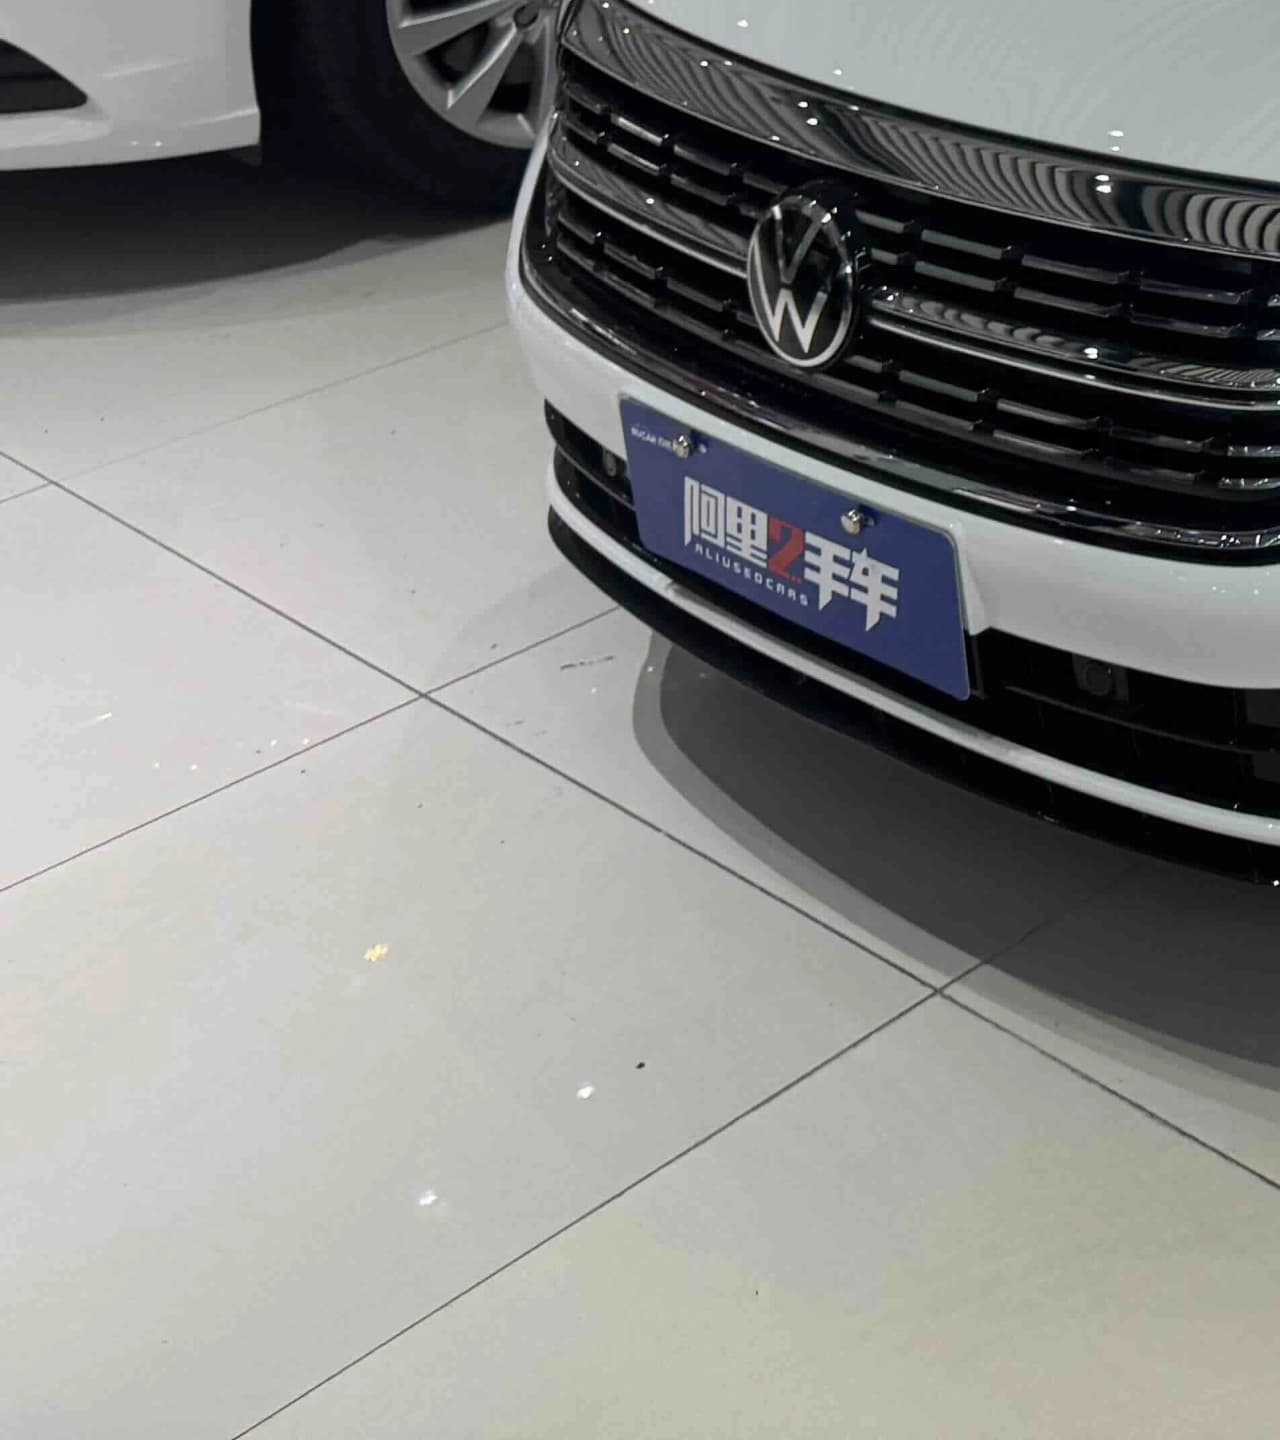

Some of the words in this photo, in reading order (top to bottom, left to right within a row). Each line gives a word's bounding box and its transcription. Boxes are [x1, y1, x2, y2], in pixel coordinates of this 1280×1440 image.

[683, 475, 900, 633] 阿里2手车
[694, 542, 810, 607] ALIUSEDCARS
